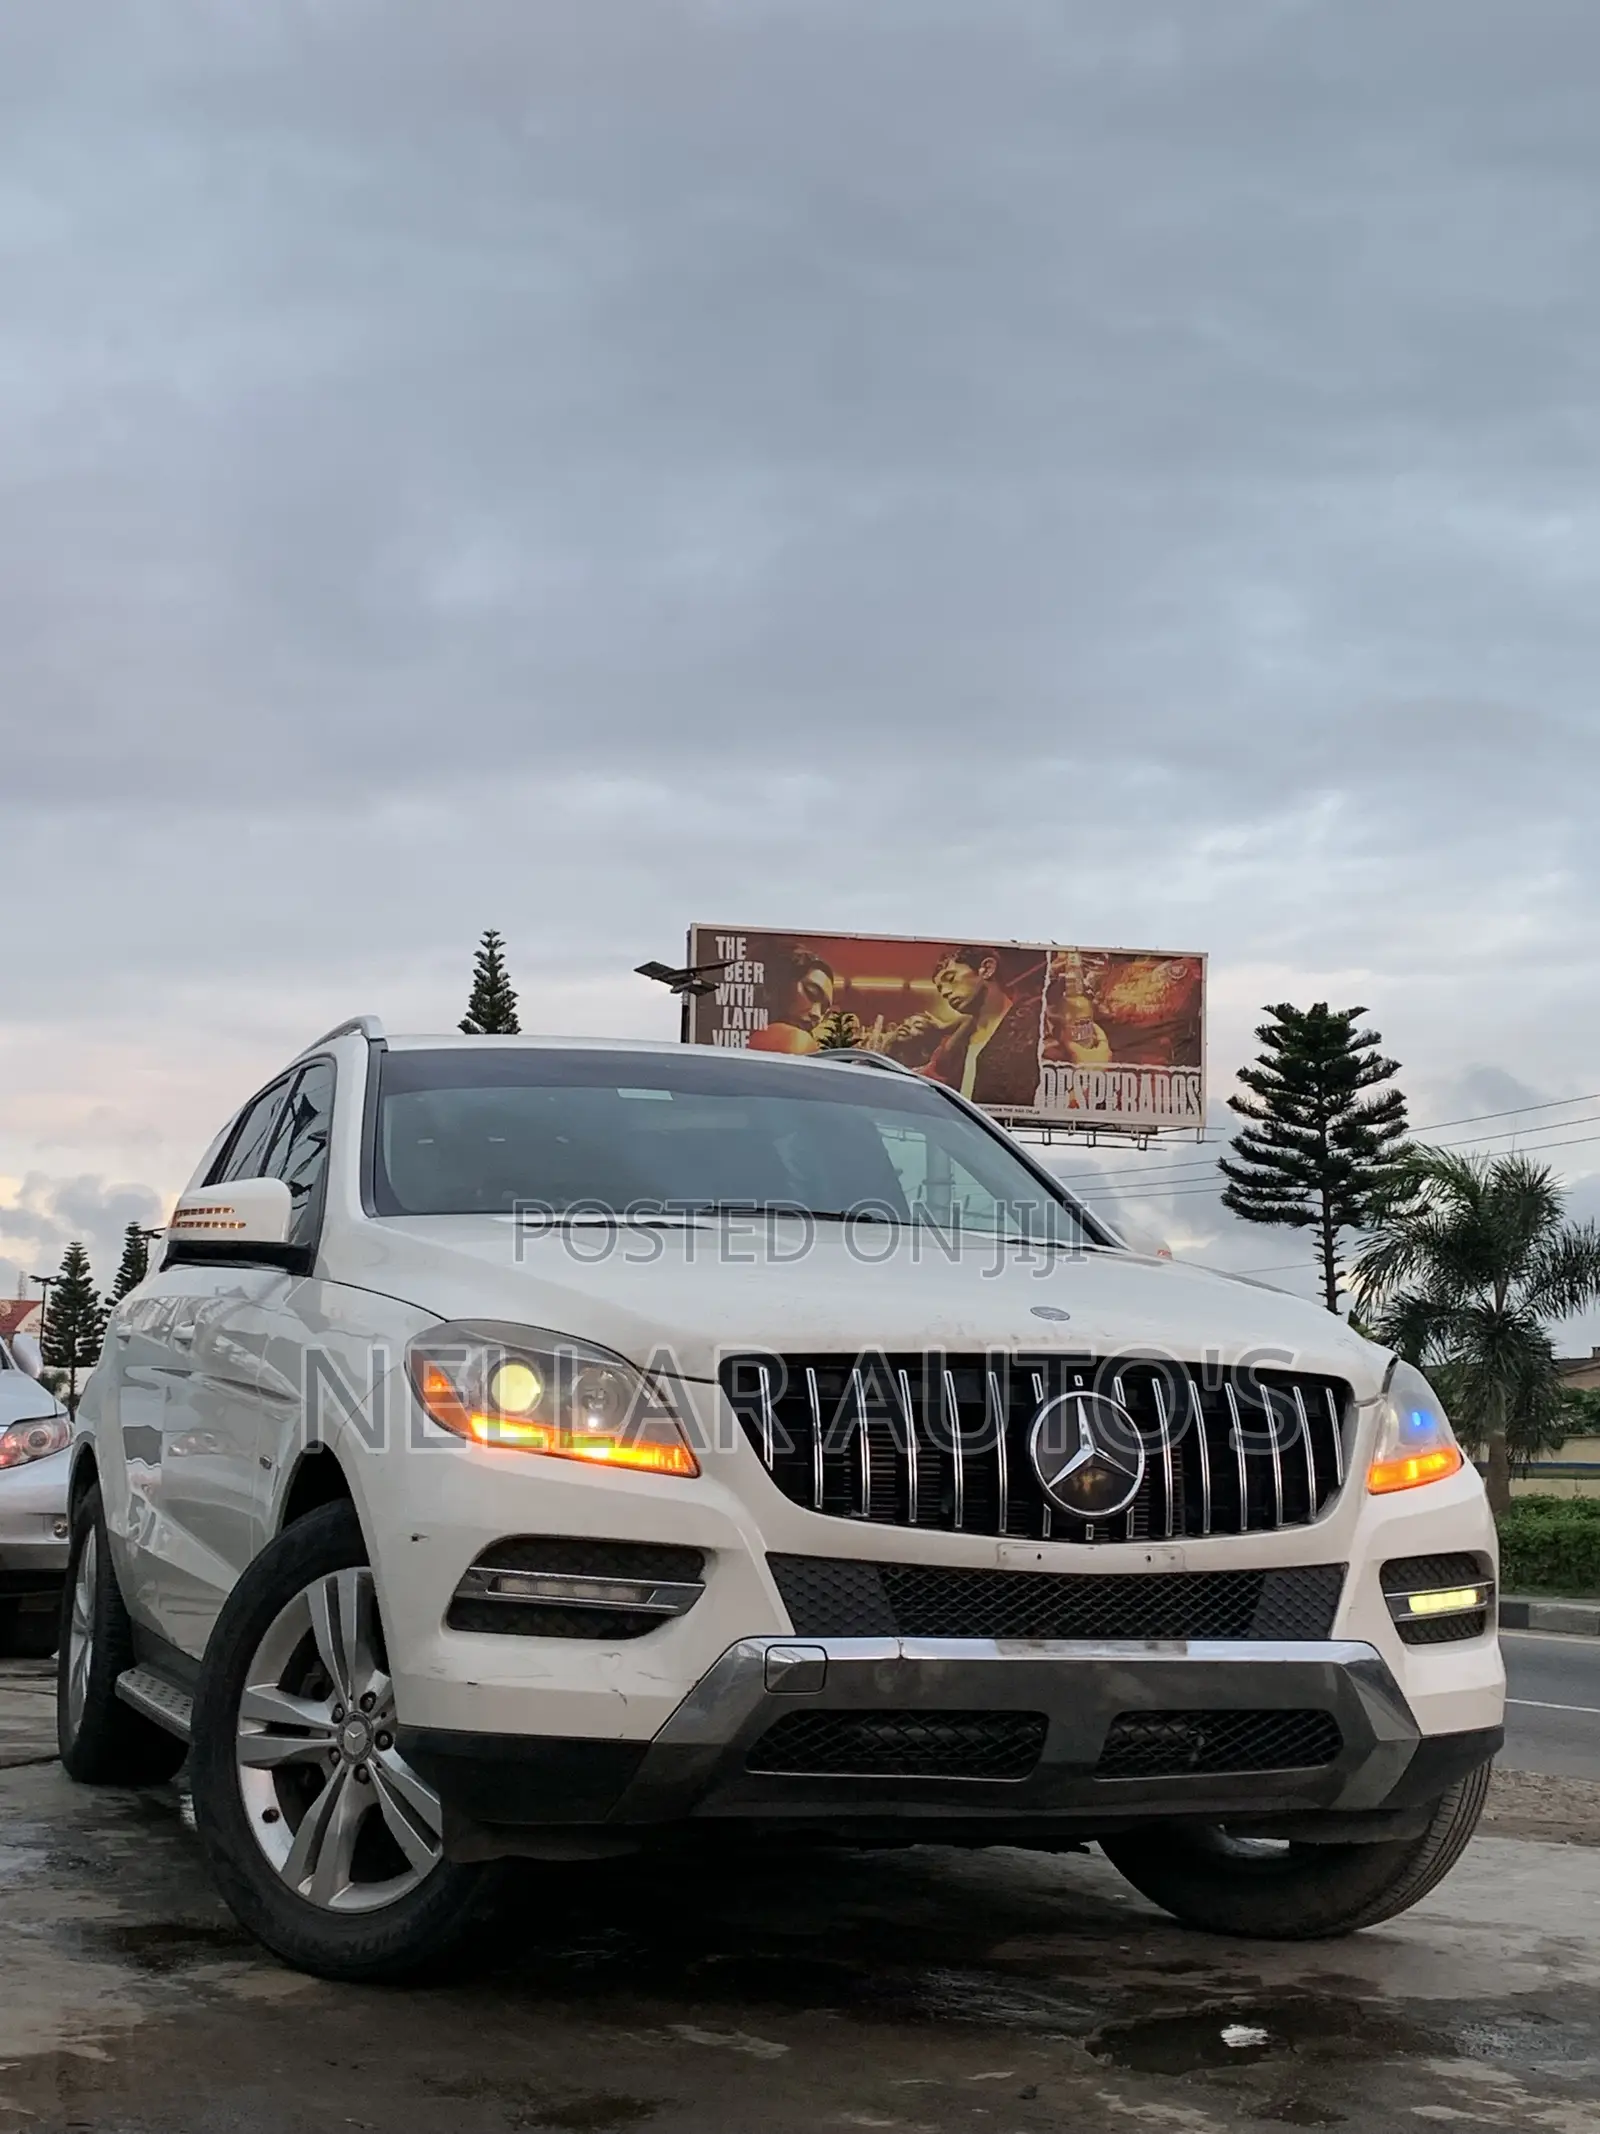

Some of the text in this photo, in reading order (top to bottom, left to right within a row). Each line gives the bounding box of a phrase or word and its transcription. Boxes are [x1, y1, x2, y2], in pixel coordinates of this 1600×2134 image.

[715, 936, 747, 960] THE
[724, 961, 764, 984] BEER
[714, 983, 754, 1006] WITH
[723, 1007, 769, 1031] LATIN
[1039, 1066, 1201, 1116] DESPERADOS
